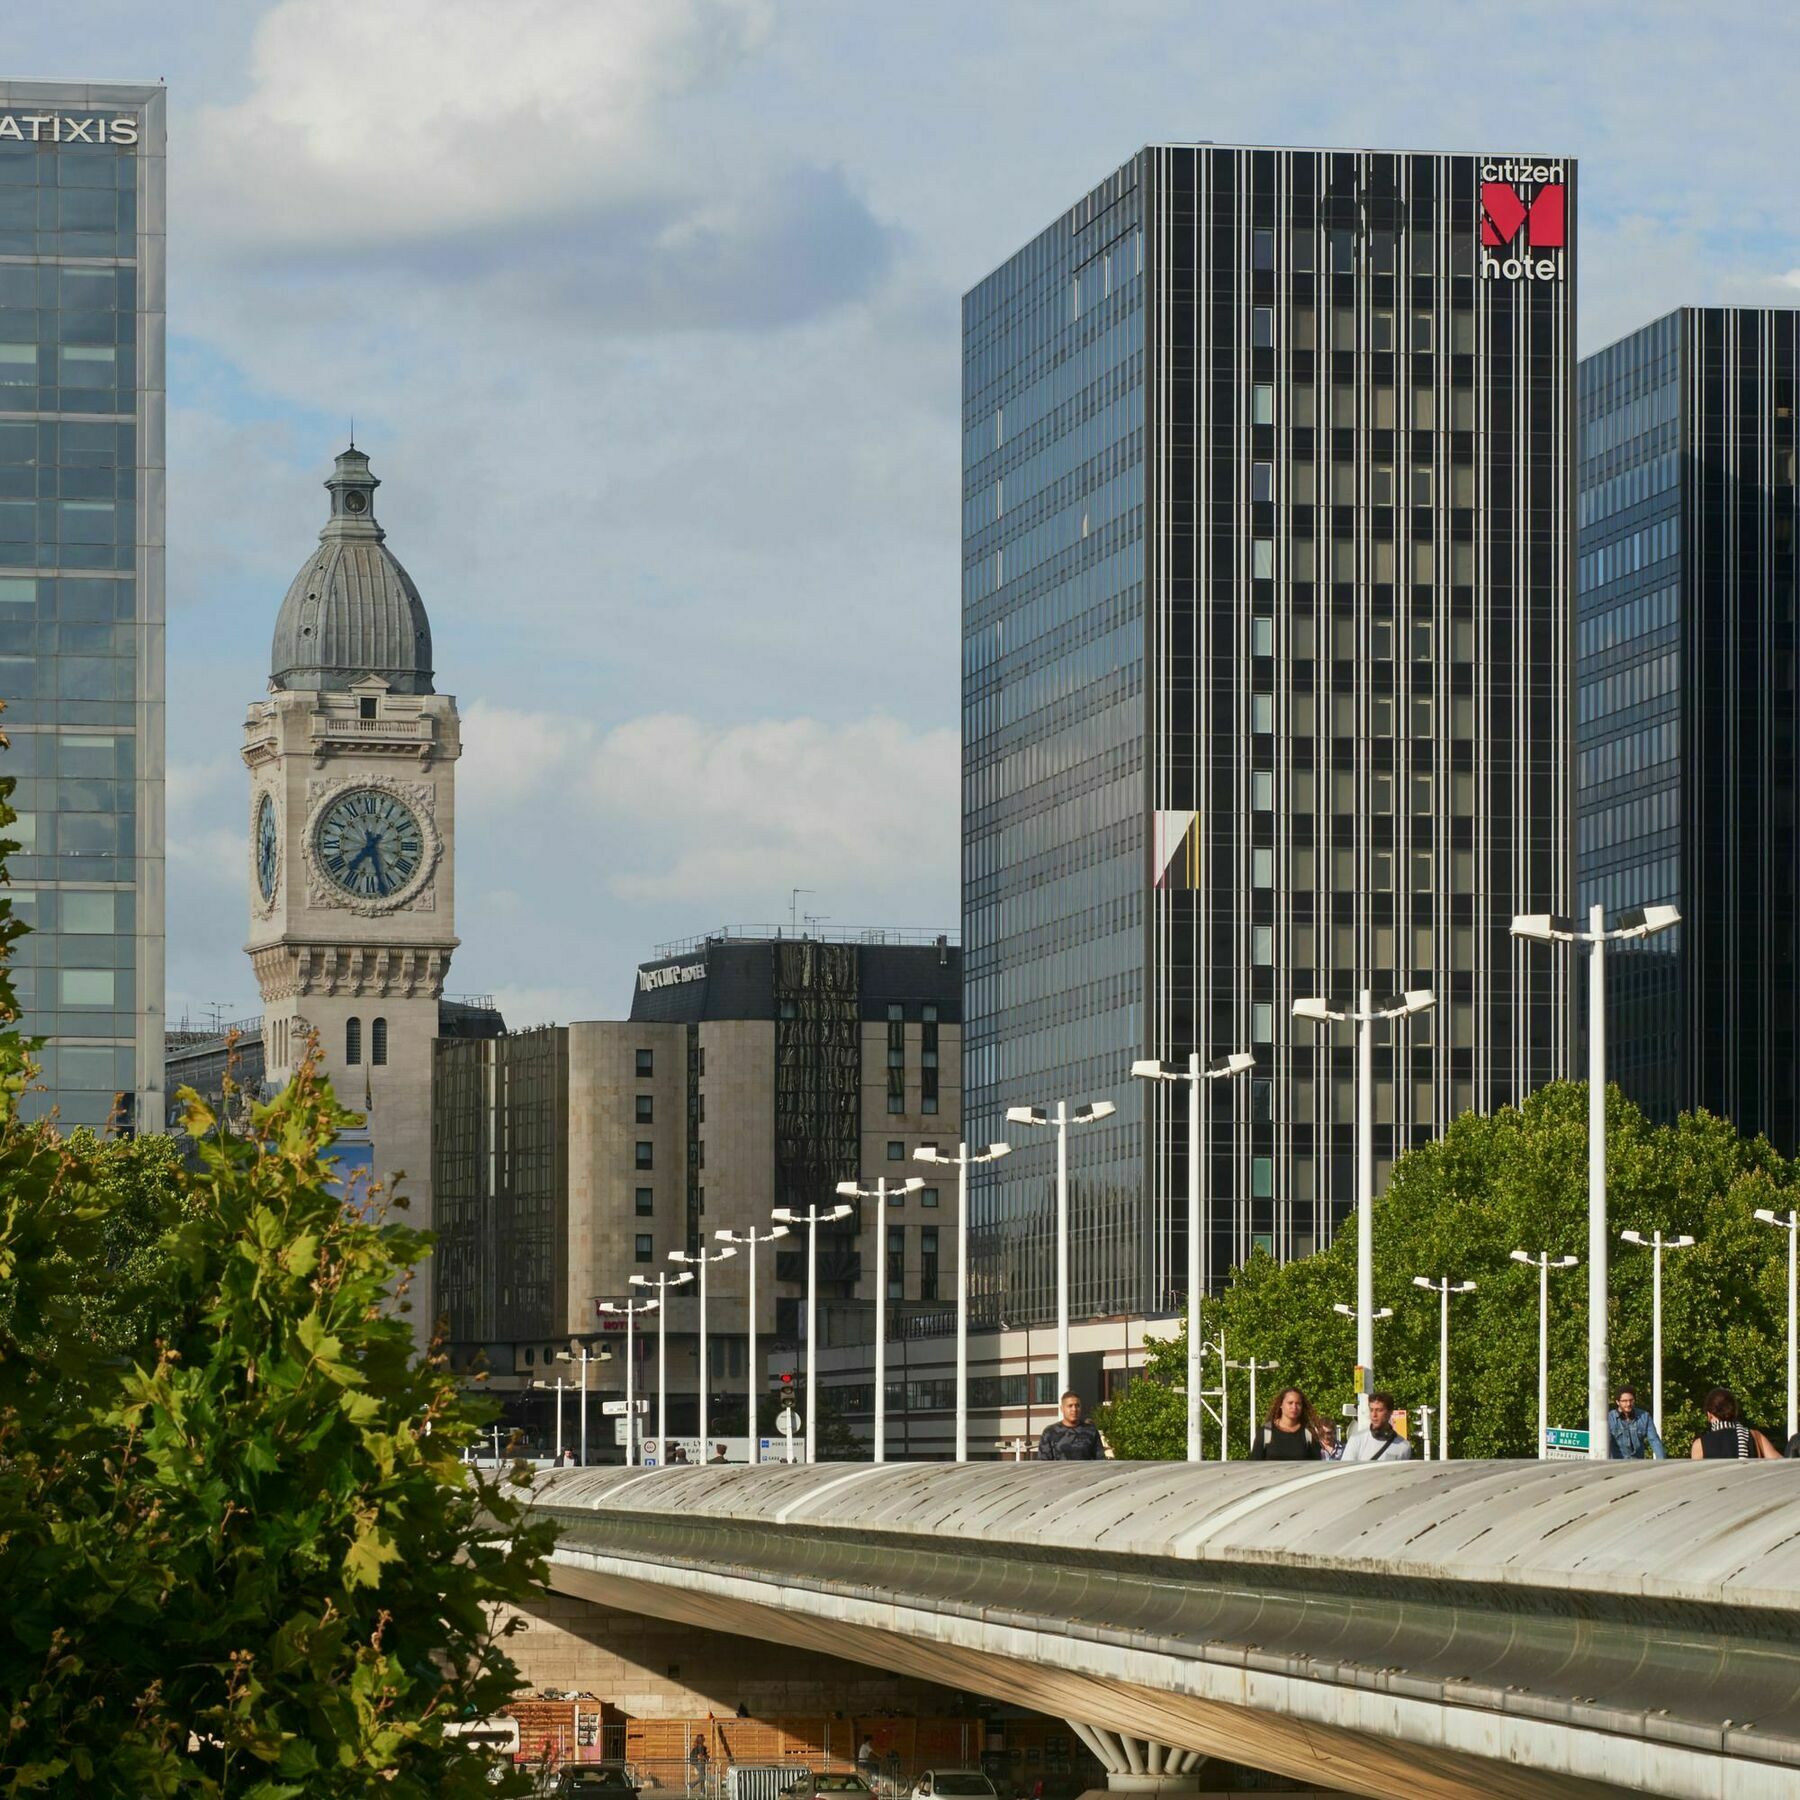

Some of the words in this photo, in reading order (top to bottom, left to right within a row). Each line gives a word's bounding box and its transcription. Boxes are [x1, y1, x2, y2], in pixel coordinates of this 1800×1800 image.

[0, 115, 138, 144] ATIXIS
[1482, 159, 1565, 183] citizen
[1482, 249, 1565, 281] hotel
[343, 802, 359, 818] XI
[364, 797, 377, 814] XII
[385, 805, 395, 819] I
[329, 818, 345, 831] X
[396, 821, 412, 832] II
[324, 839, 340, 849] IX
[401, 841, 418, 851] III
[603, 1320, 641, 1331] HOTL
[1560, 1431, 1578, 1439] METZ
[1559, 1438, 1581, 1446] NANCY
